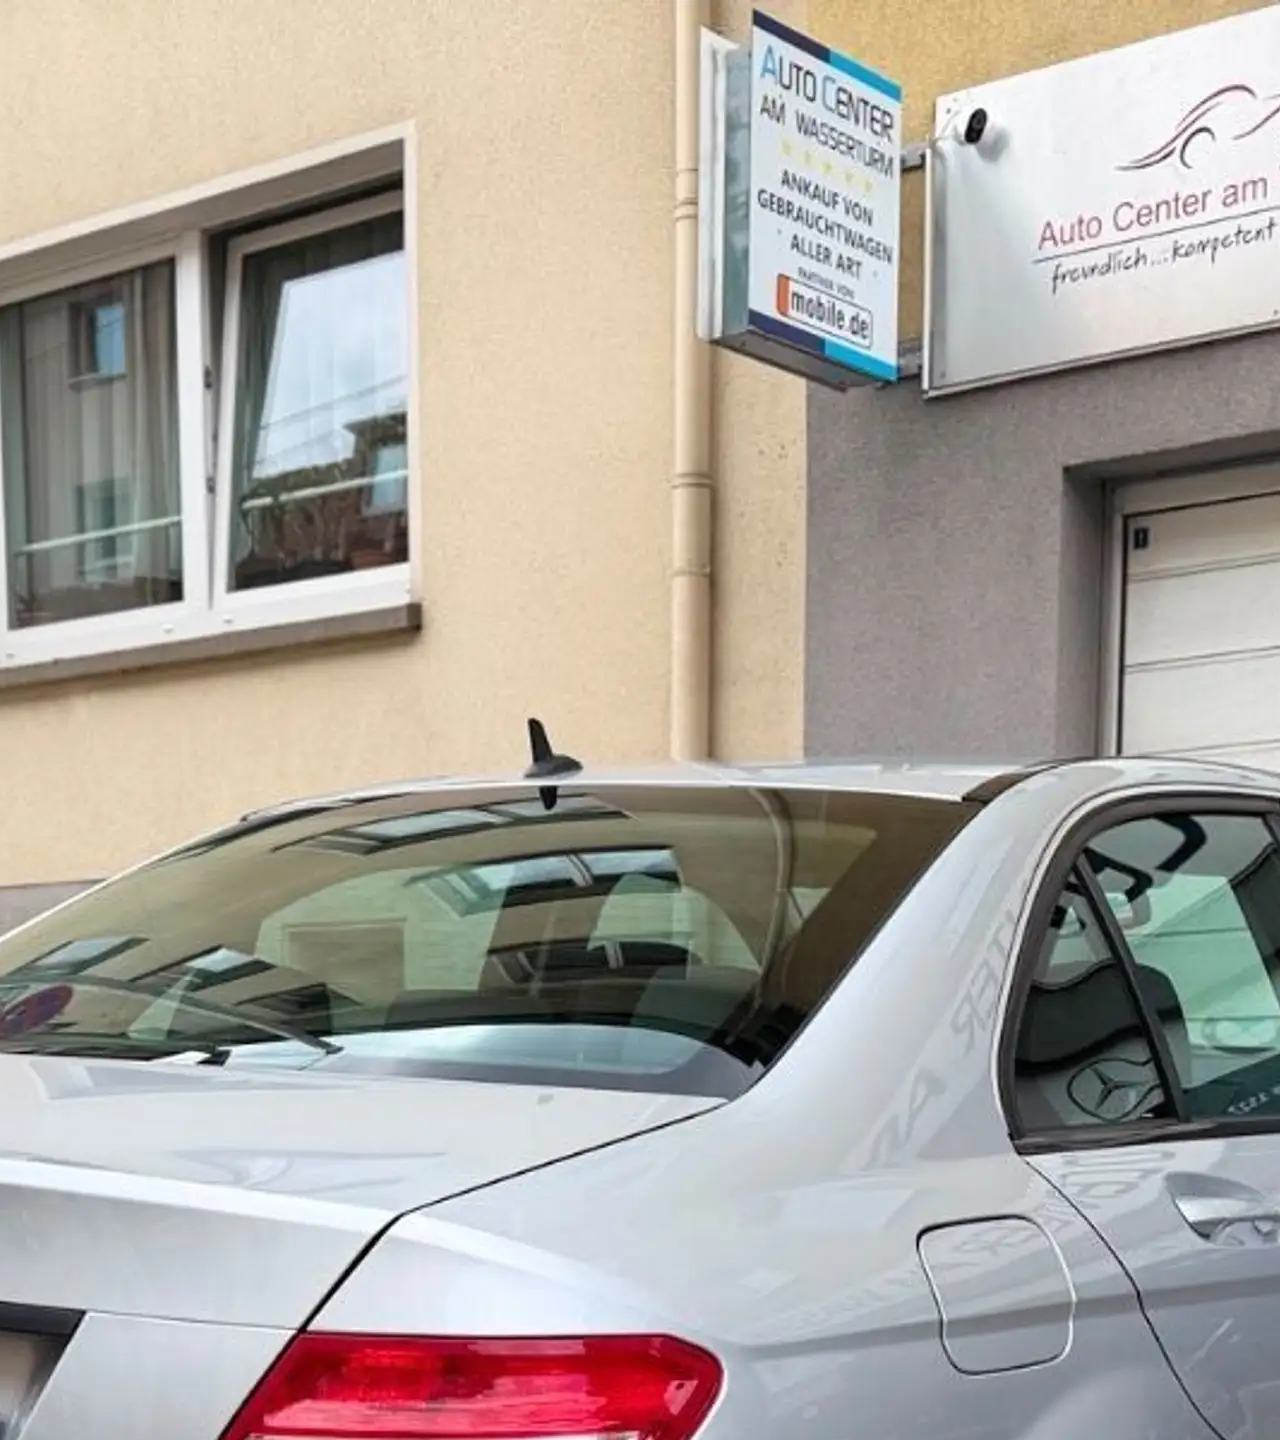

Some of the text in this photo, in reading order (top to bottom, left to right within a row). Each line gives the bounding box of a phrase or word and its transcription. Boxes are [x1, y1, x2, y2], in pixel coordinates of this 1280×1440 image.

[760, 44, 894, 142] AUTO CENTER
[760, 93, 894, 179] AM WASSERTURM
[757, 189, 893, 264] GEBRAUCHTWAGEN
[781, 169, 874, 226] ANKAUF VON
[1038, 214, 1103, 251] Auto
[1113, 188, 1212, 232] Center
[1222, 176, 1269, 208] am
[790, 233, 863, 281] ALLER ART
[791, 290, 869, 340] mobile.de
